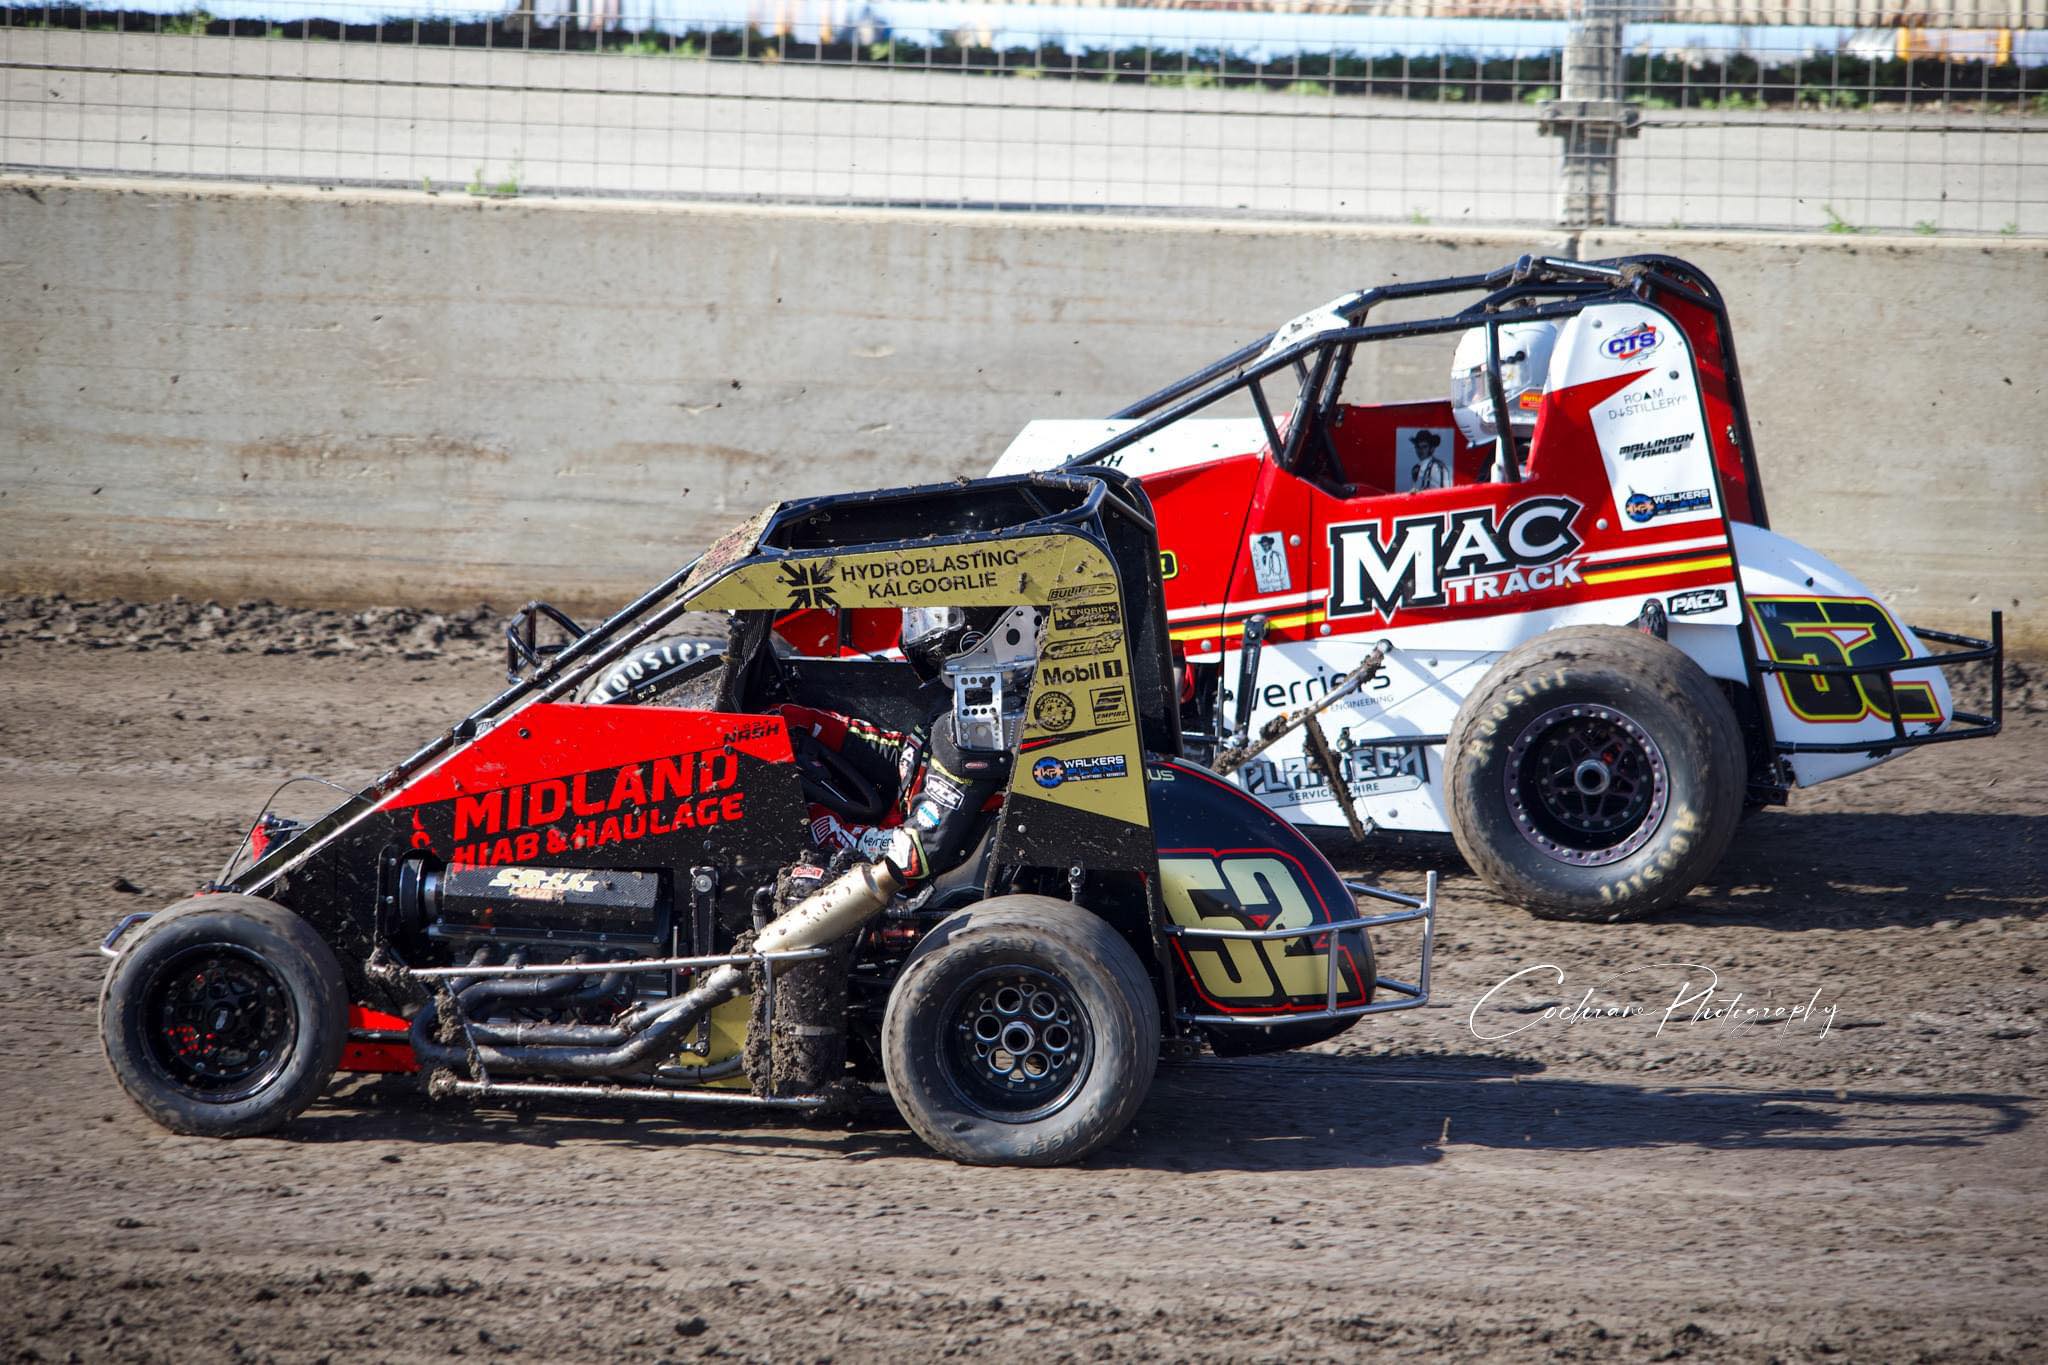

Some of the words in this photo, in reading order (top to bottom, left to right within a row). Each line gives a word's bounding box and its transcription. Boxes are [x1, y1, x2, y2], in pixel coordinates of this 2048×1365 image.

[1608, 332, 1656, 354] CTS
[1619, 432, 1695, 455] MALLINSON
[1632, 443, 1682, 461] FAMILY
[1653, 489, 1709, 504] WALKERS
[841, 549, 1019, 582] HYDROBLASTING
[1334, 501, 1574, 612] MAC
[868, 571, 998, 599] KALGOORLIE
[1448, 560, 1582, 602] TRACK
[1055, 605, 1116, 621] KENDRICK
[1042, 662, 1100, 686] Mobil
[1063, 756, 1124, 768] WALKERS
[454, 751, 738, 841] MIDLAND
[452, 832, 540, 868] HIAB
[571, 792, 744, 851] HAULAGE
[1158, 858, 1350, 998] 52
